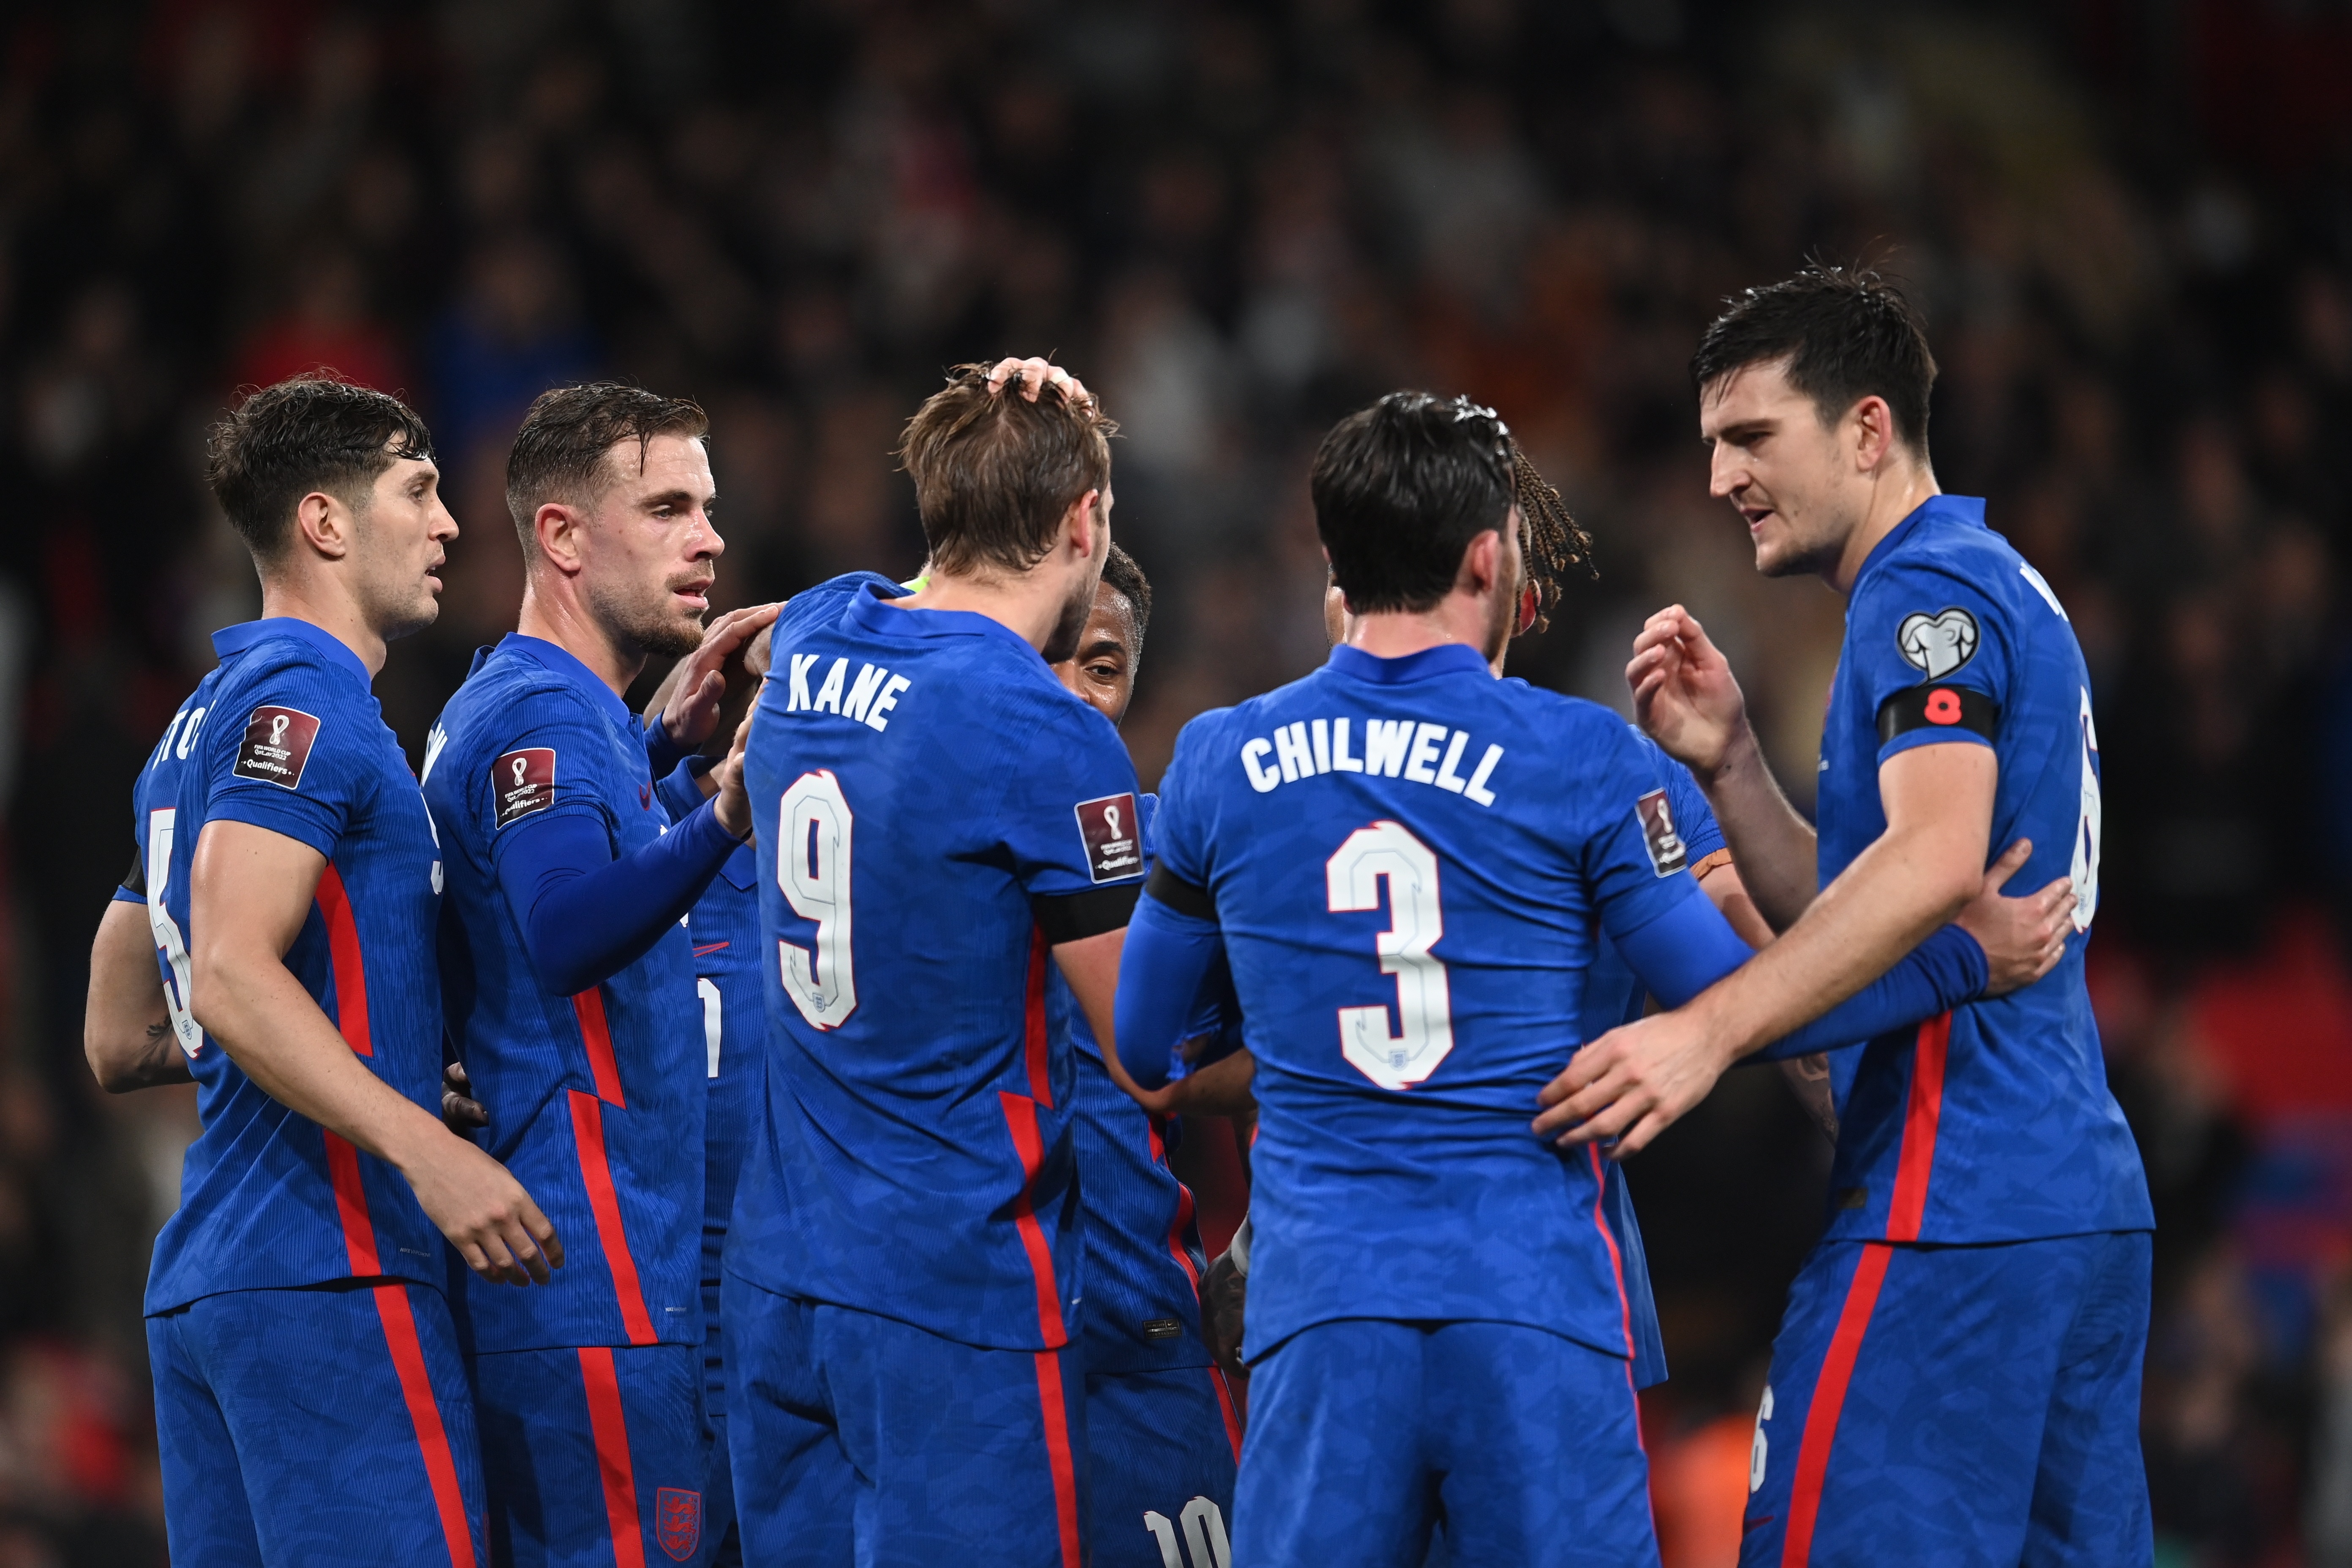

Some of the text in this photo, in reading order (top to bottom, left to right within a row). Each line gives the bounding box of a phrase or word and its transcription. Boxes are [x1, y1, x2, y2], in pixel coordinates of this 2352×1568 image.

[787, 653, 912, 732] KANE
[247, 759, 288, 775] Qualifiers
[1240, 717, 1505, 807] CHILWELL
[777, 768, 858, 1032] 9
[1325, 819, 1454, 1091] 3
[1750, 1384, 1774, 1494] 6
[1143, 1495, 1232, 1568] 10
